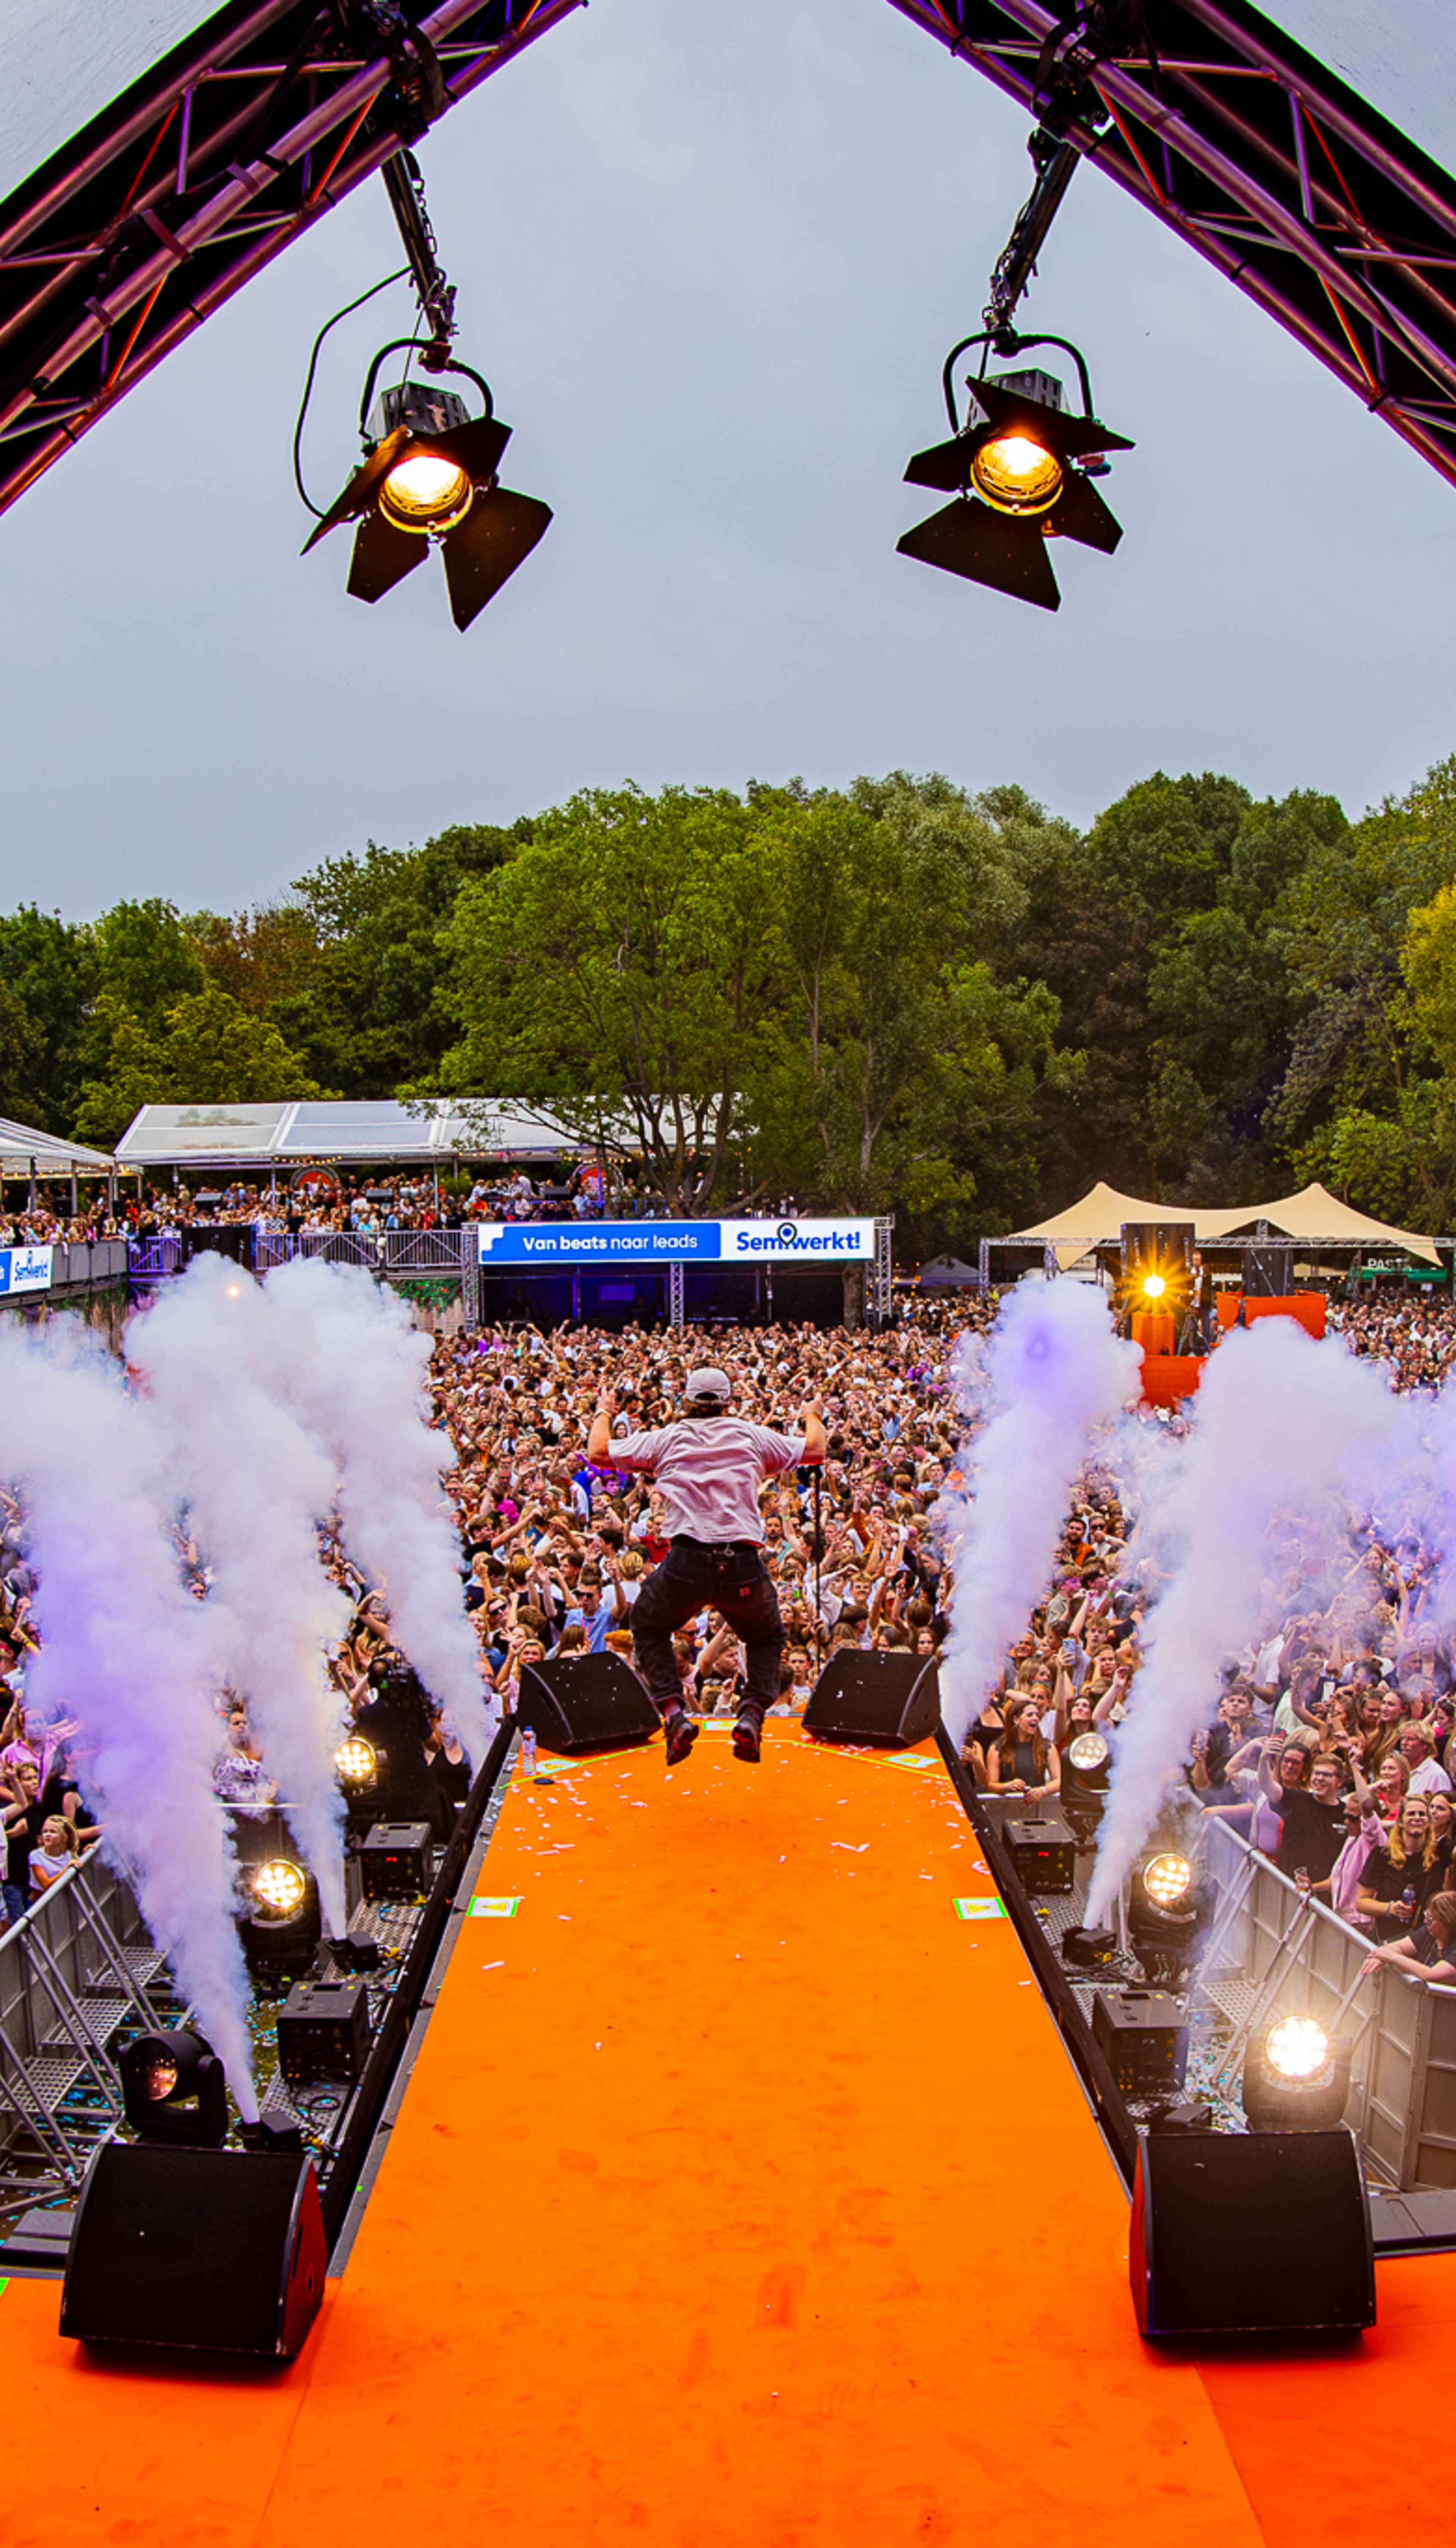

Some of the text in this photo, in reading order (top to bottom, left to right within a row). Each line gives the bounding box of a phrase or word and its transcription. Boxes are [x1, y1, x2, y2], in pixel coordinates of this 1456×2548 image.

[523, 1234, 698, 1250] Van beats naar leads
